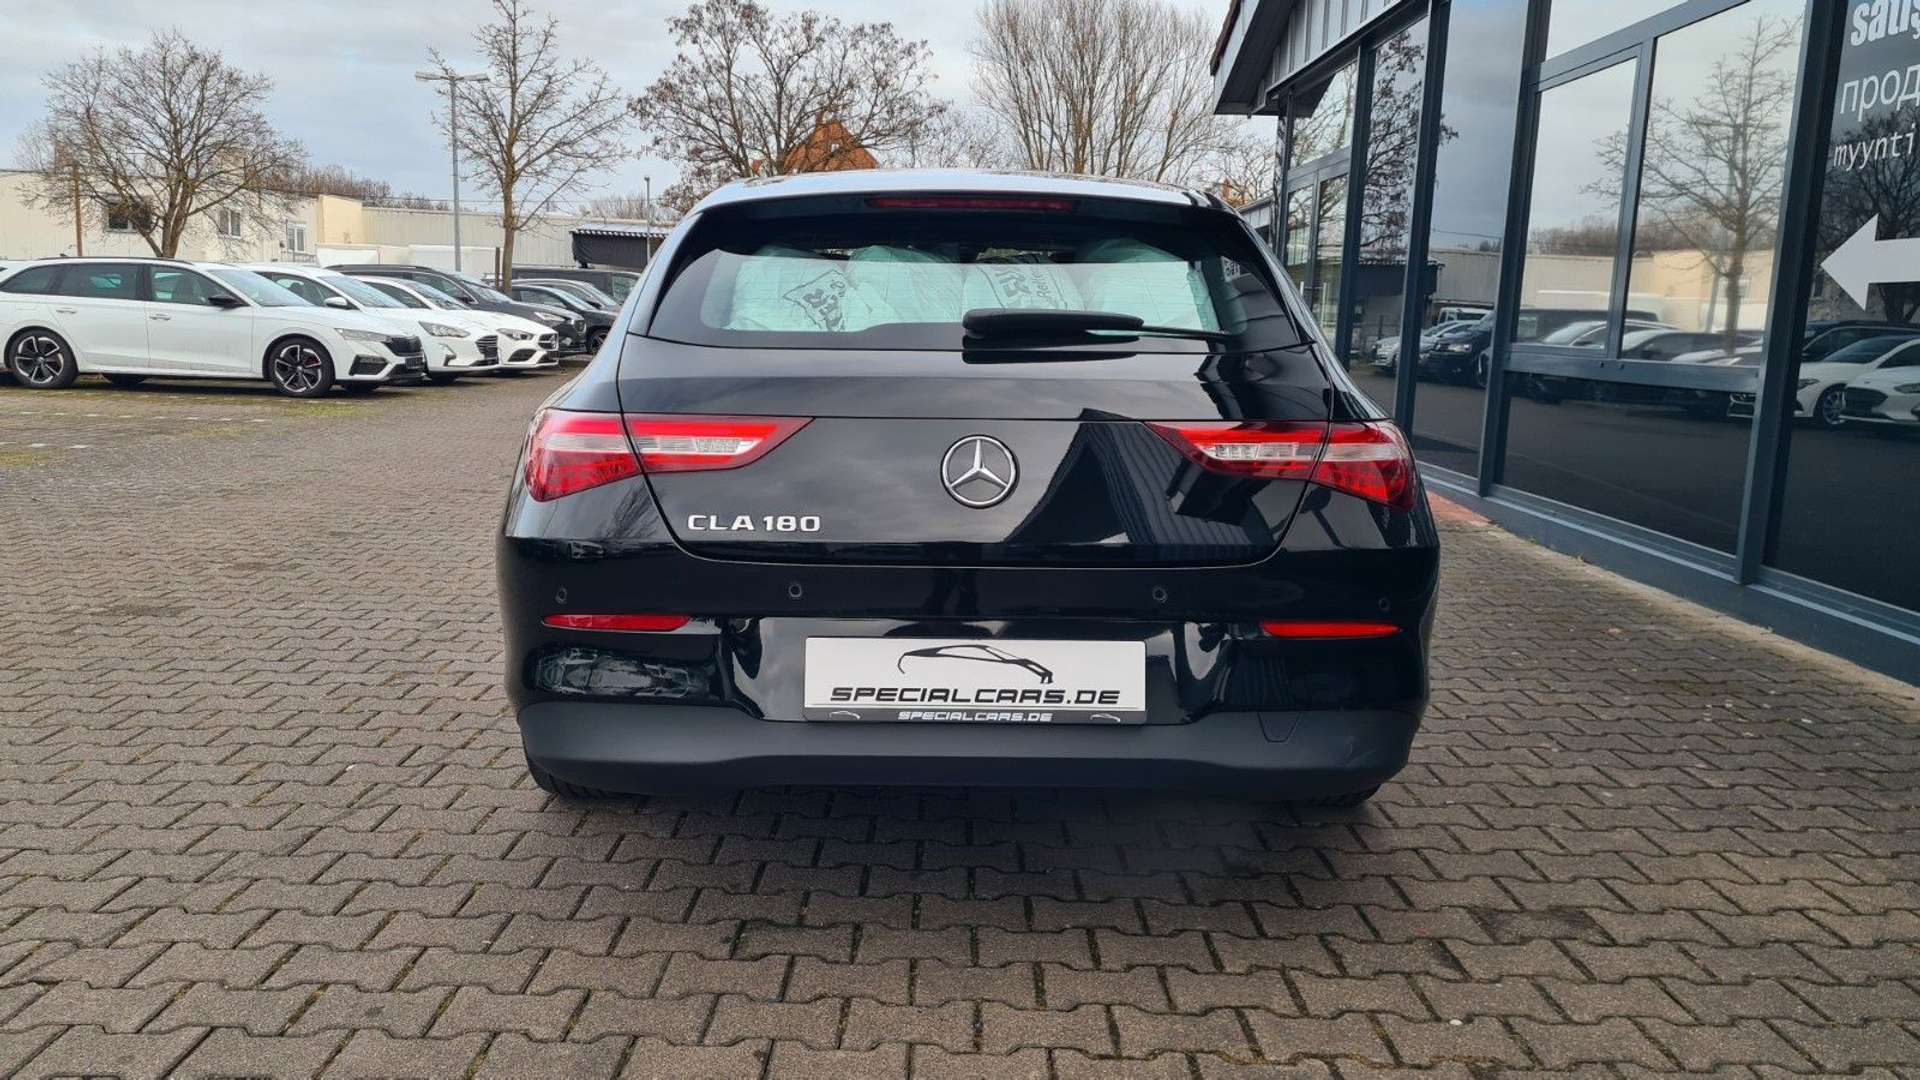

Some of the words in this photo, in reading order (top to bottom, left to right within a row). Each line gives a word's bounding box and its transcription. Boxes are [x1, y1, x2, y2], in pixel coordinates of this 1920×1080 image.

[1833, 122, 1916, 171] myynti
[687, 514, 755, 531] CLA
[763, 515, 821, 532] 180
[830, 687, 1121, 705] SPECIALCARS.DE
[897, 711, 1053, 722] SPECIALCARS.DE
